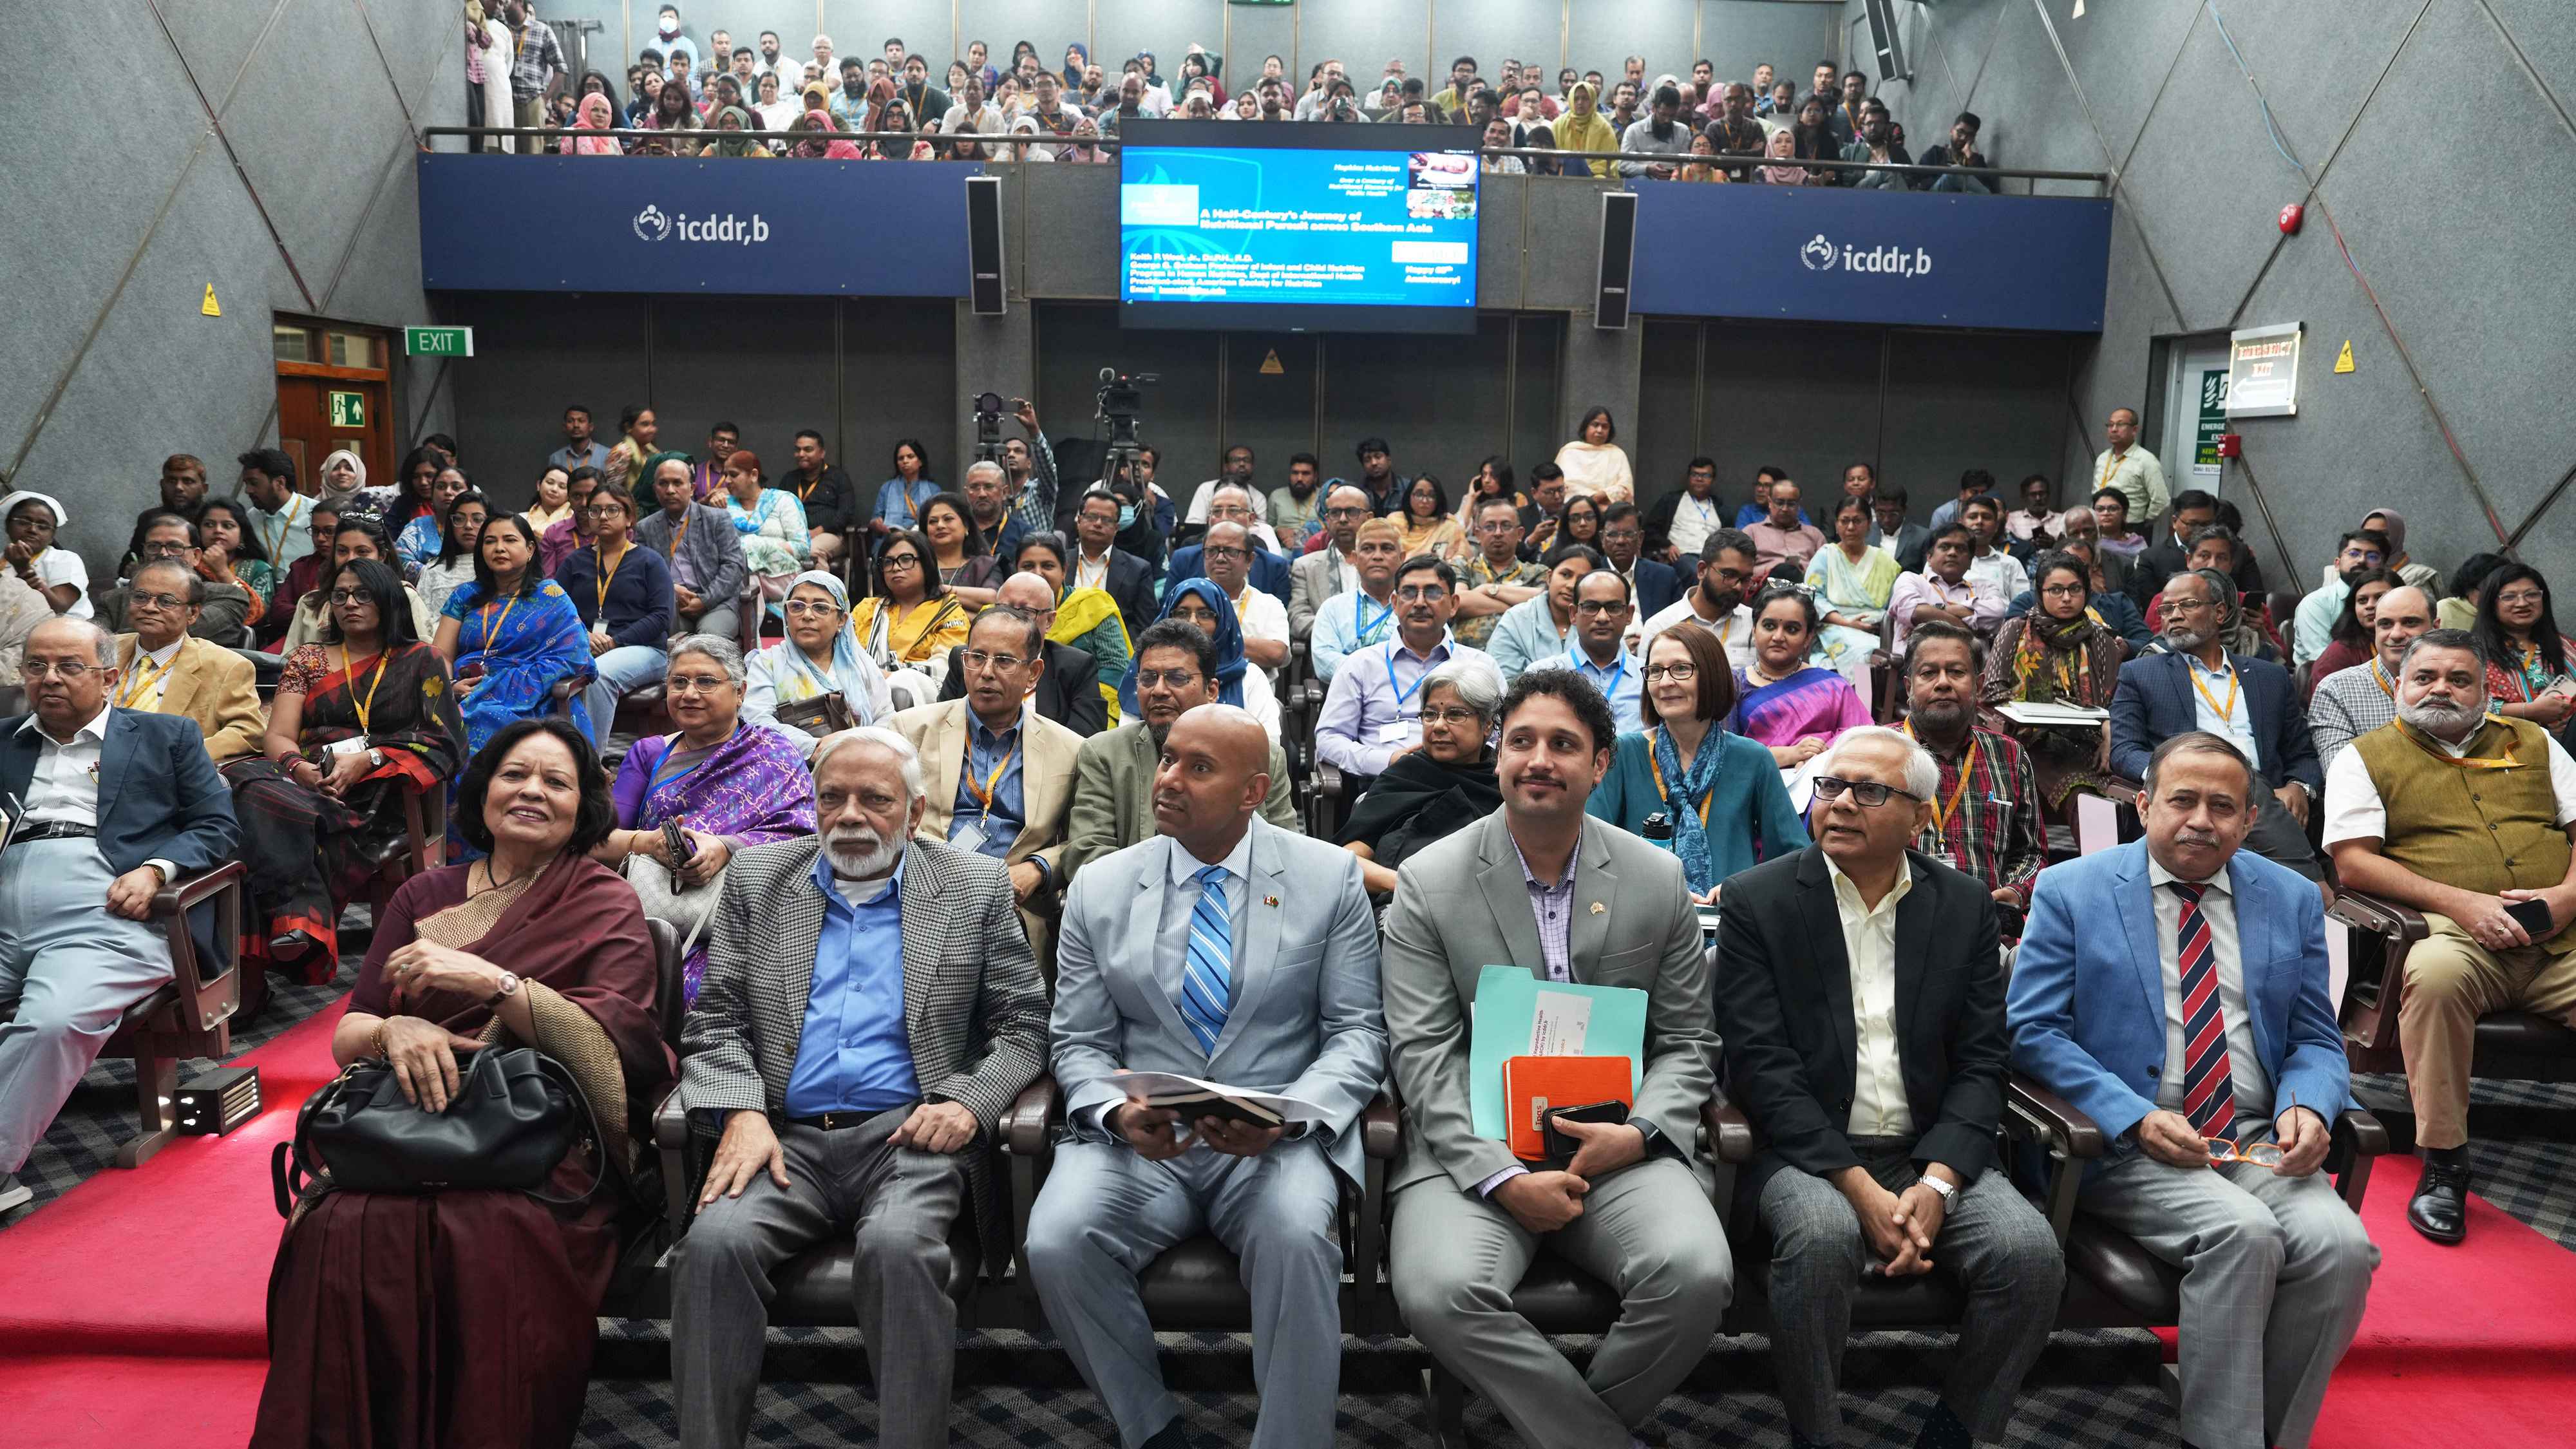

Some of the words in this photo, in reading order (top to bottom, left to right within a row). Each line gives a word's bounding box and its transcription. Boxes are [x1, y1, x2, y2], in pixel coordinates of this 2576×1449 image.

[676, 213, 770, 246] icddr,b
[1348, 211, 1363, 222] of
[1842, 243, 1932, 278] icddr,b
[419, 332, 454, 351] EXIT
